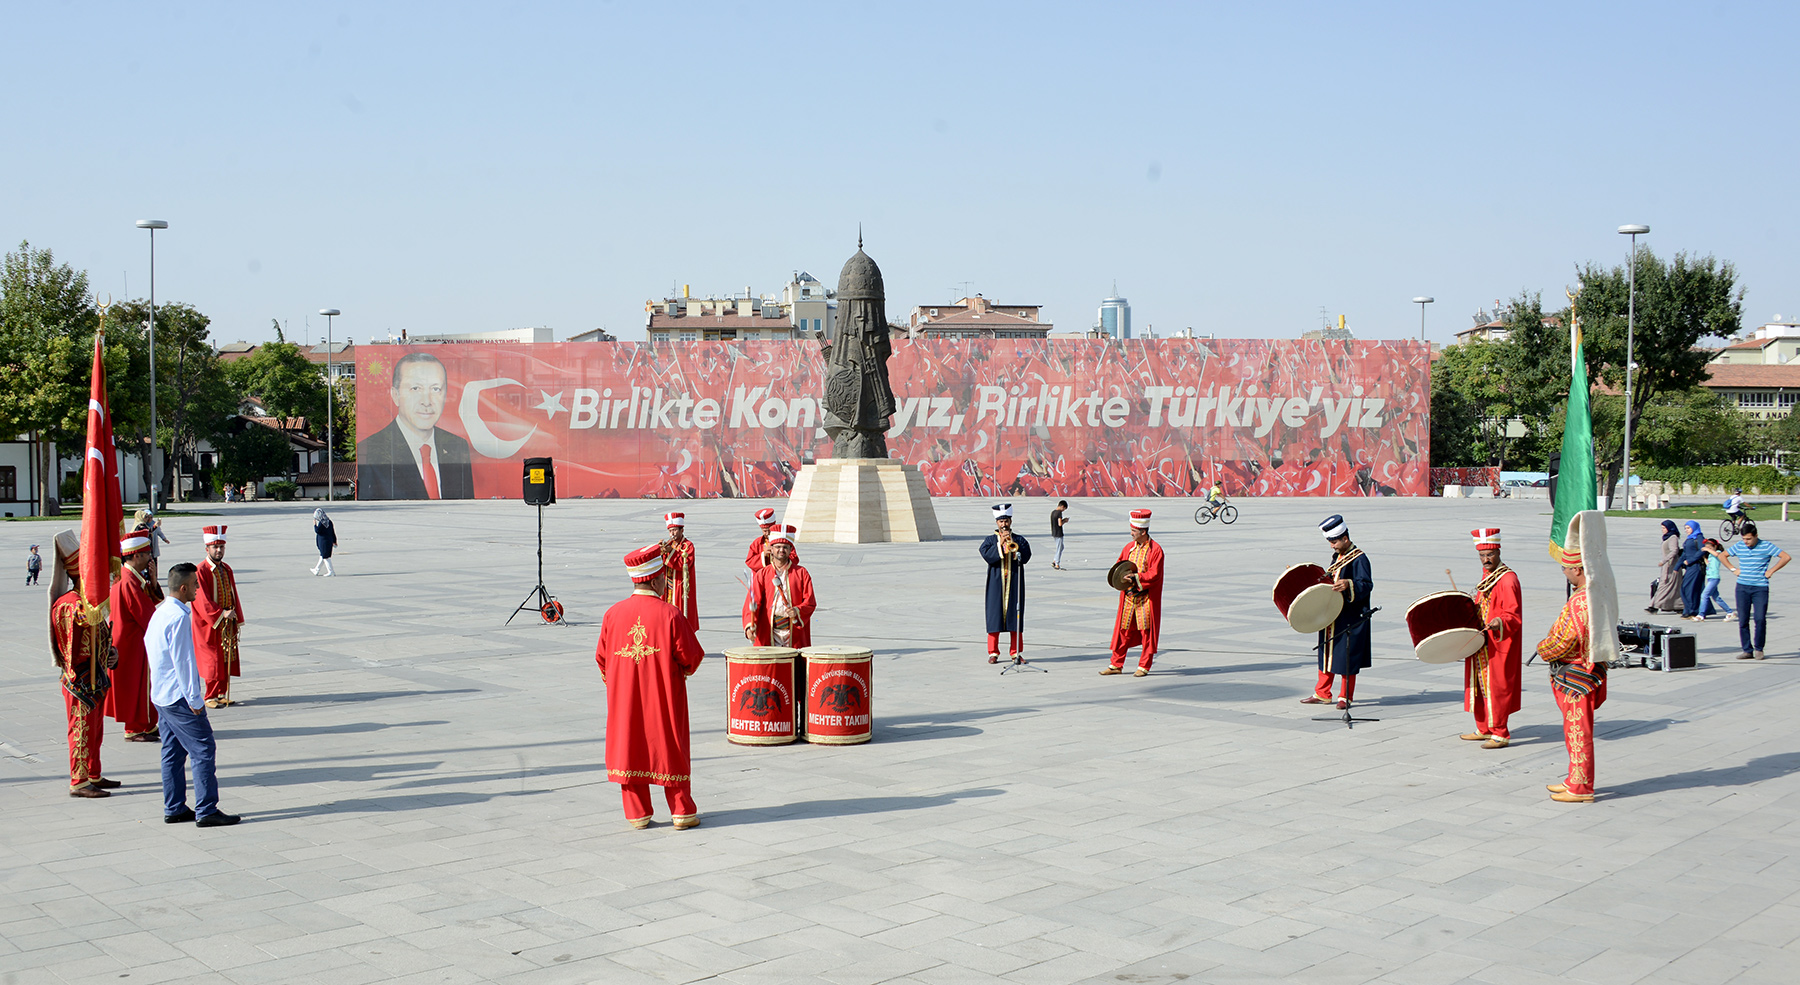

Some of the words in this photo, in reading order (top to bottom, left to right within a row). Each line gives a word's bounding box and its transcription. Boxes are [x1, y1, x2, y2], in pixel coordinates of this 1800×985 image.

[569, 386, 719, 430] Birlikte
[977, 384, 1131, 428] Birlikte
[1143, 383, 1386, 440] Türkiye'yiz
[731, 683, 741, 702] KONYA
[740, 674, 771, 685] BÜYÜKŞEHİR
[771, 678, 790, 705] BELEDİYESİ
[810, 678, 822, 697] KONYA
[821, 669, 852, 680] BÜYÜKŞEHİR
[853, 673, 868, 697] BELEDİYESİ
[731, 717, 761, 732] MEHTER
[762, 721, 791, 732] TAKIMI
[808, 712, 842, 726] MEHTER
[844, 713, 869, 727] TAKIMI
